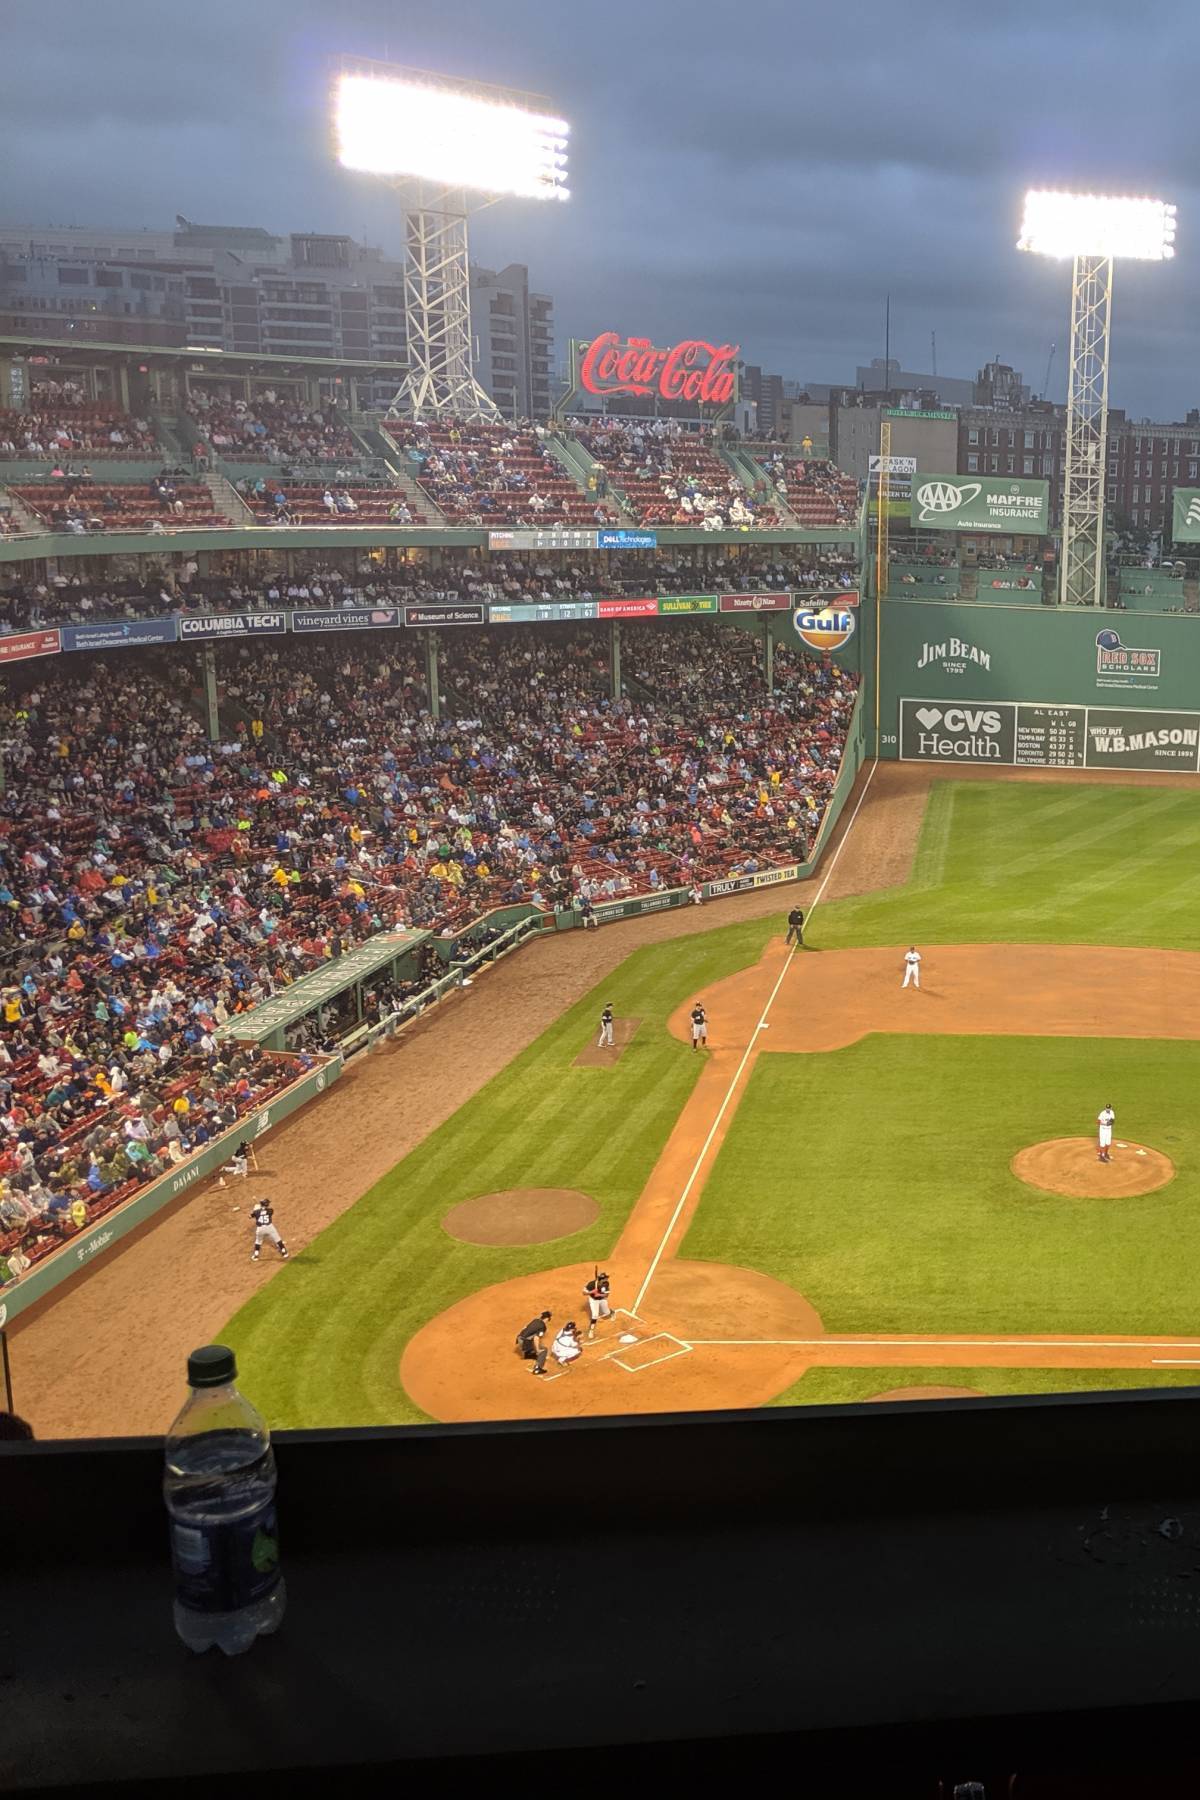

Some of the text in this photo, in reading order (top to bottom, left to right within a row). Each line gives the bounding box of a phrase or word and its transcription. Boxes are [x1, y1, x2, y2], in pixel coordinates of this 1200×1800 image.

[581, 332, 738, 400] Coca-Cola
[922, 485, 955, 510] AAA
[986, 495, 1043, 506] MAPFRE
[990, 508, 1039, 518] INSURANCE
[298, 614, 341, 628] vineyard
[343, 614, 368, 624] vines
[565, 610, 570, 618] 12
[182, 617, 244, 632] COLUMBIA
[246, 616, 280, 628] TECH
[797, 612, 851, 632] Gulf
[918, 638, 991, 672] JIM BEAM
[1102, 651, 1156, 666] RED SOX
[1102, 664, 1156, 672] SCHOLARS
[944, 709, 1002, 734] CVS
[1090, 728, 1122, 736] WHO BUT
[882, 735, 896, 744] 310
[918, 733, 1001, 758] Health
[756, 870, 794, 884] TWISTED TEA
[712, 882, 736, 894] TRULY
[258, 1215, 270, 1224] 45
